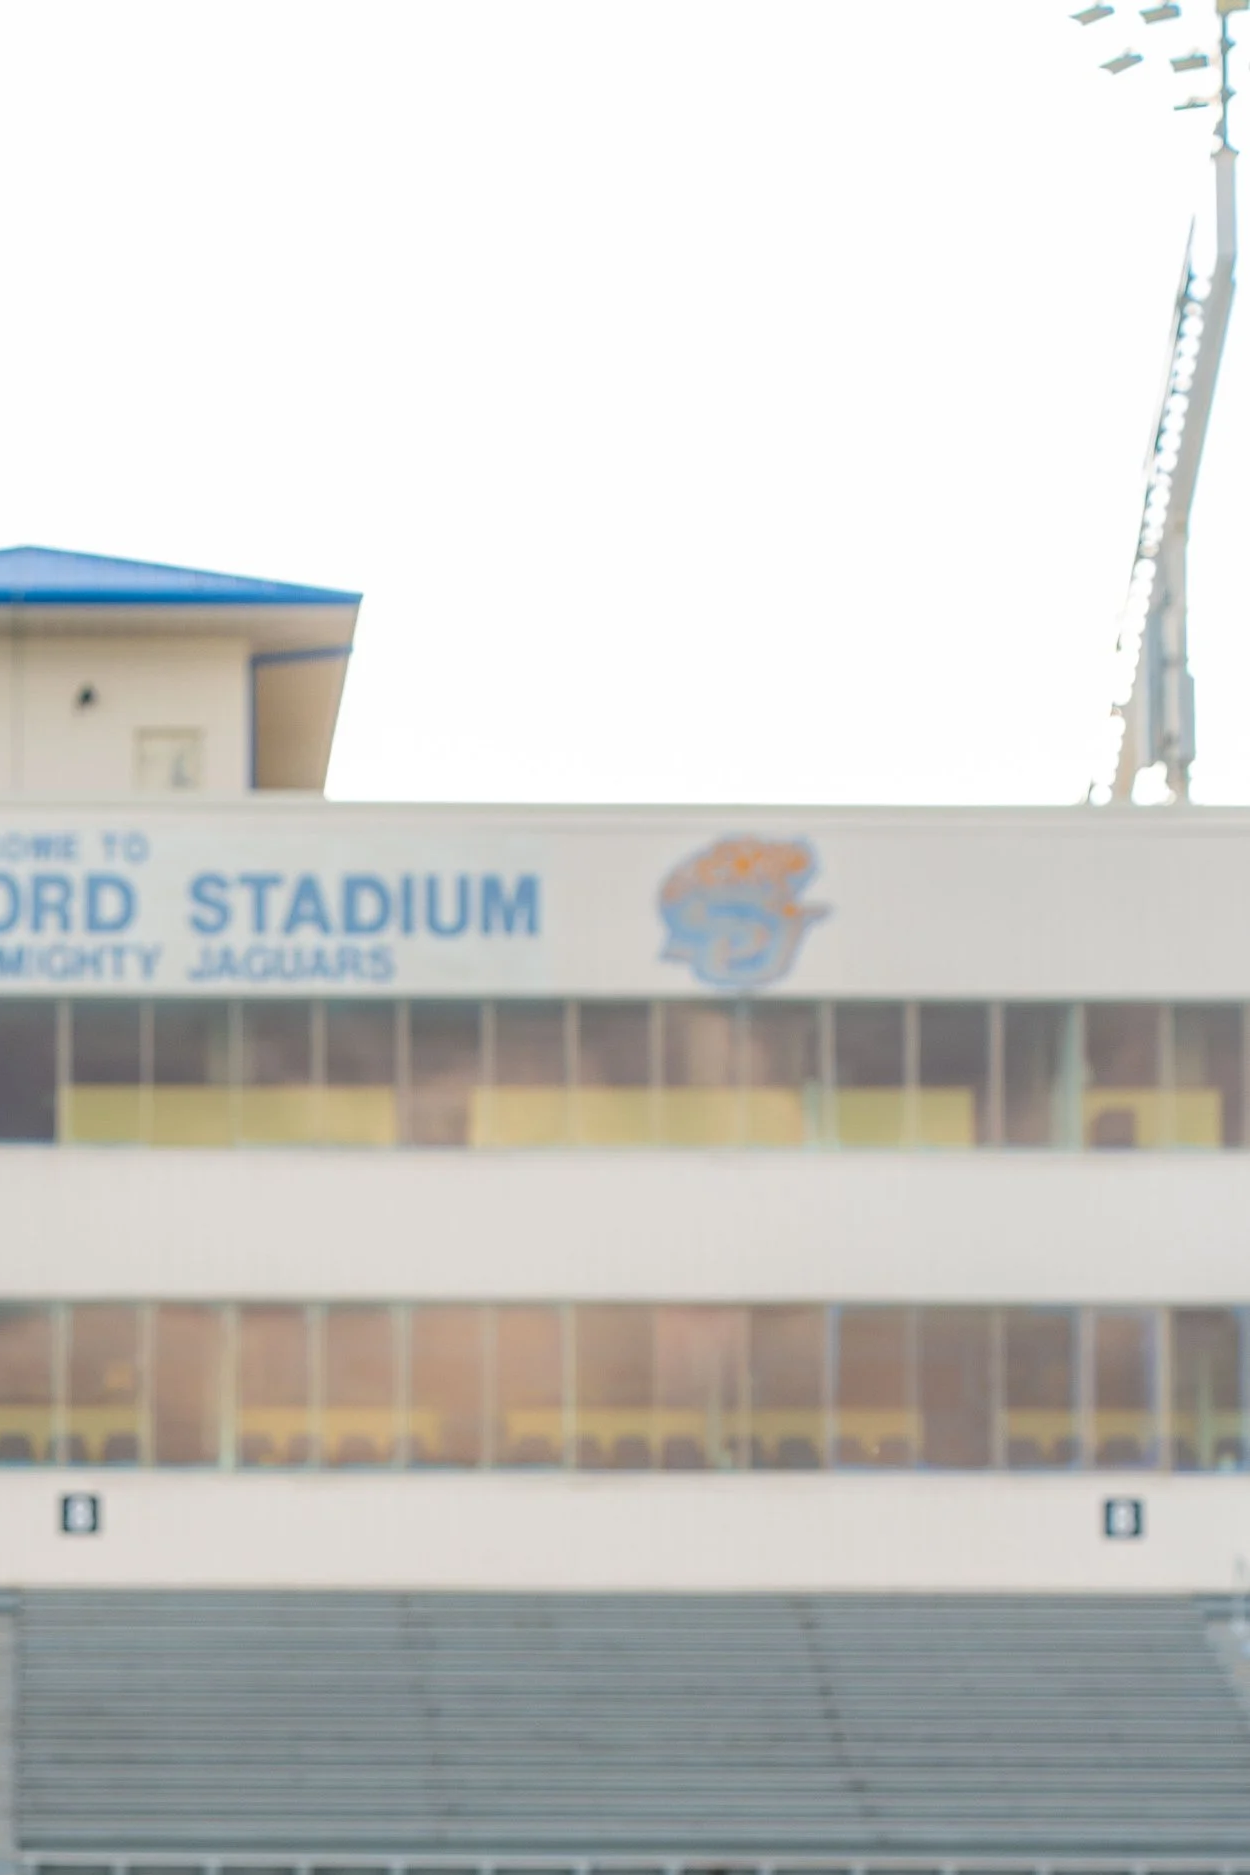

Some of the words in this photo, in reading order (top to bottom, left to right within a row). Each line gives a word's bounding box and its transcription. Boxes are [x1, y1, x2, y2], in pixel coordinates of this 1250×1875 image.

[100, 832, 152, 864] TO
[187, 871, 542, 938] STADIUM
[187, 945, 396, 982] JAGUARS
